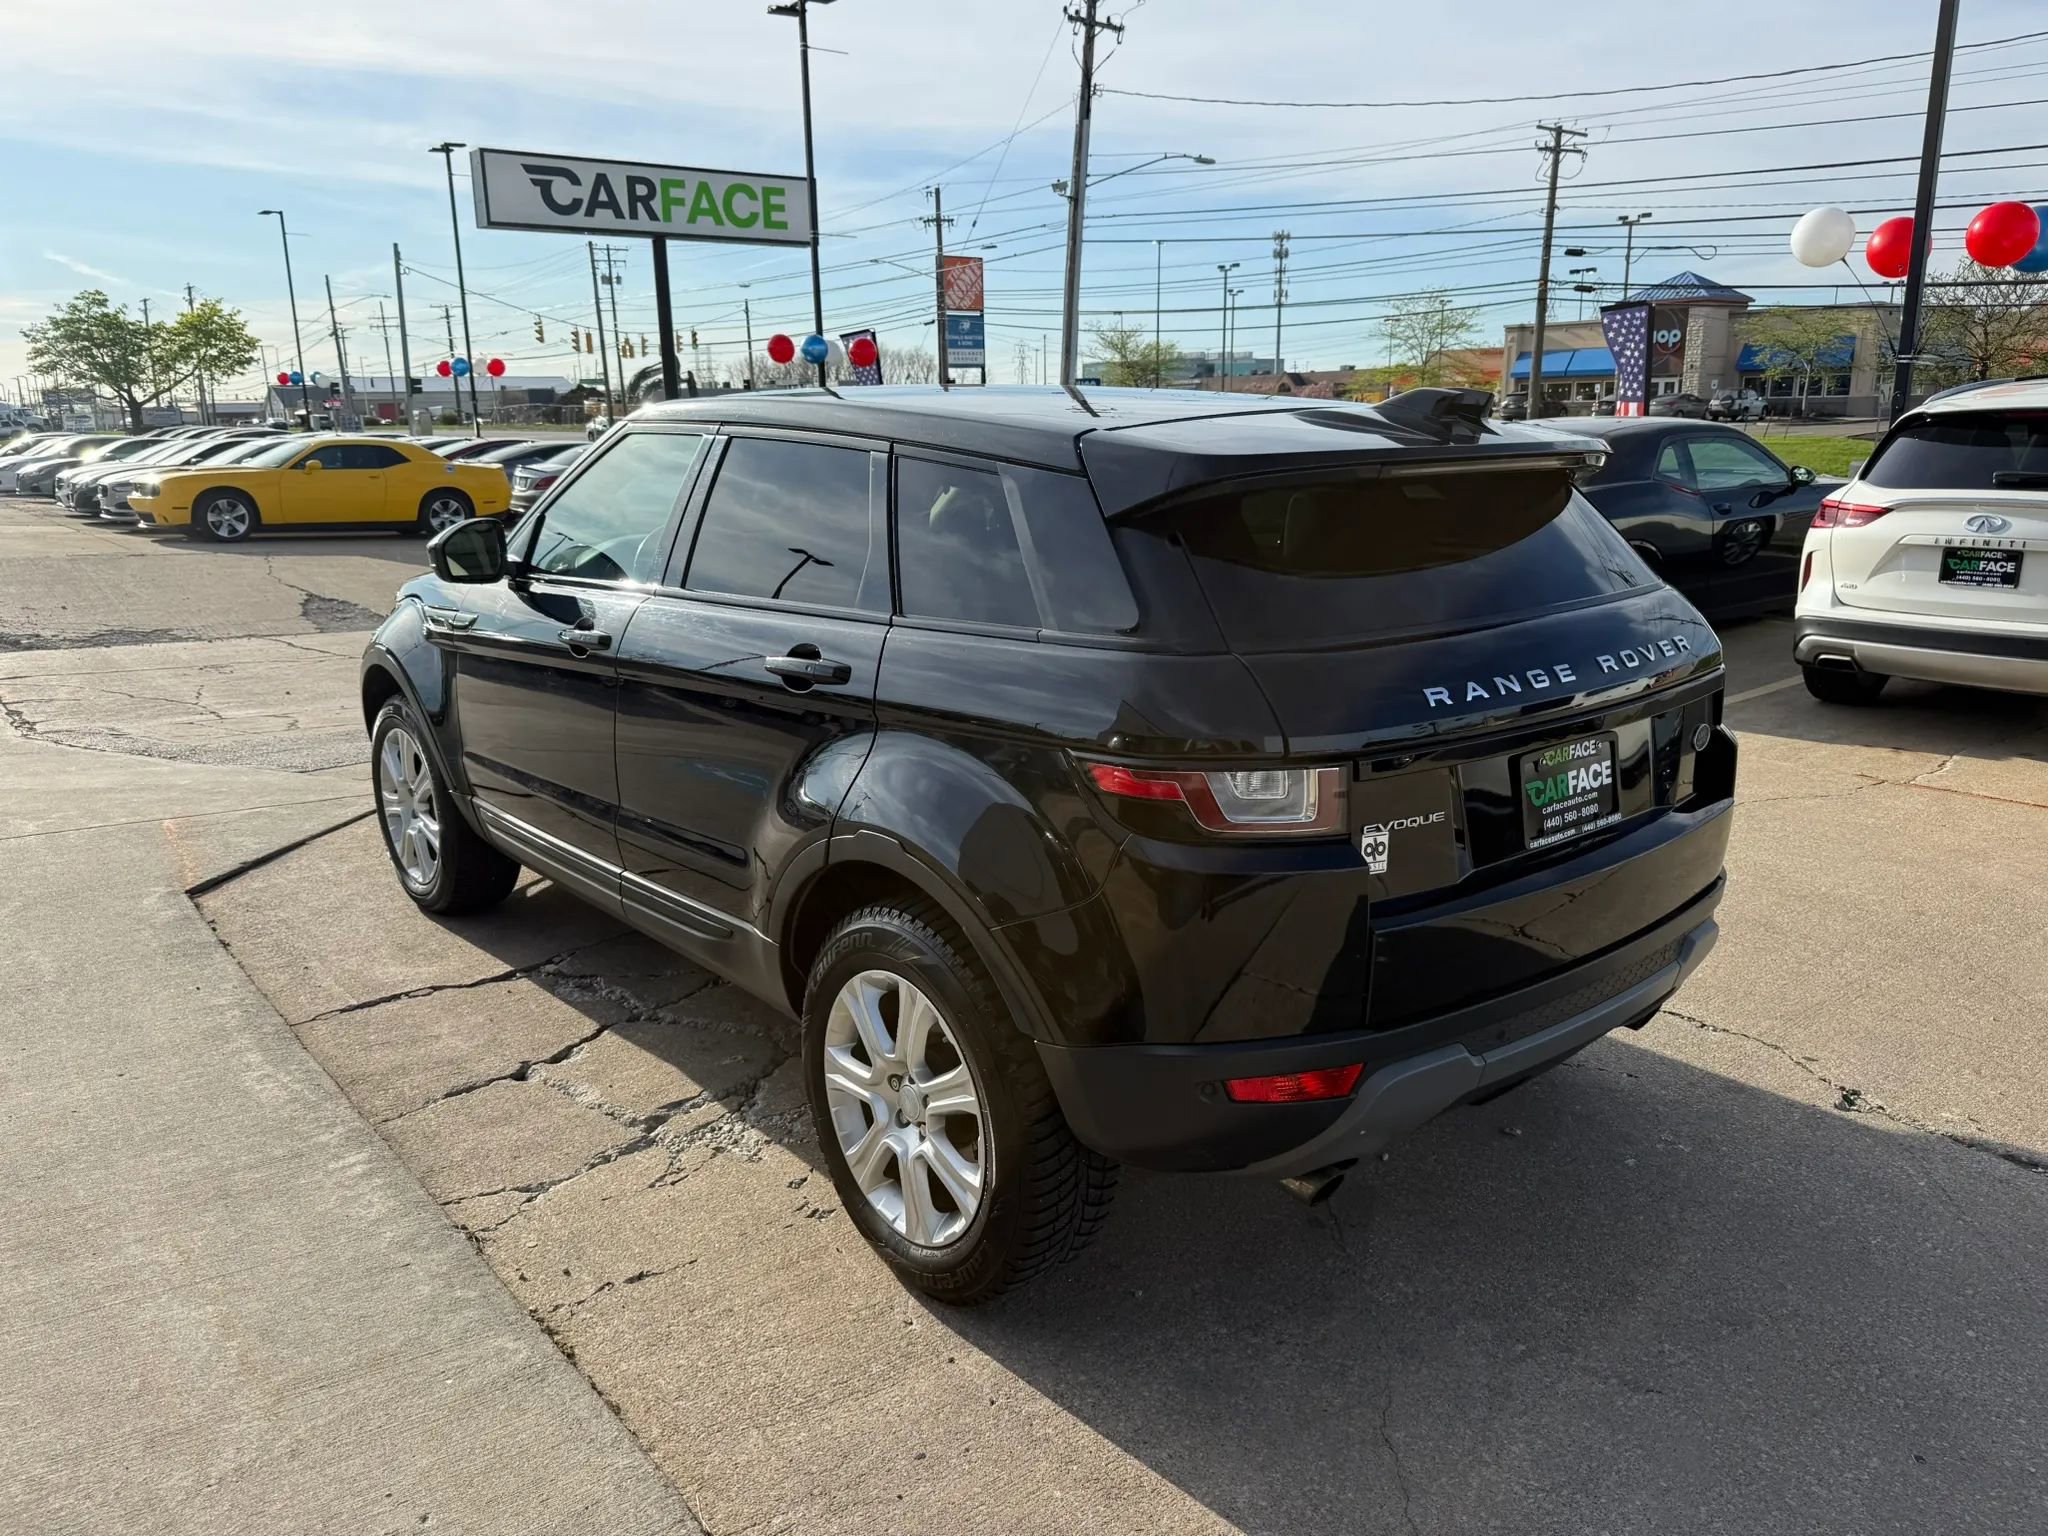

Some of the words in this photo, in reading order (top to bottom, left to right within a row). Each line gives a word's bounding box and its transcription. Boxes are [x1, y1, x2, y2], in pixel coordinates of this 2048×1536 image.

[520, 163, 789, 231] CARFACE
[1934, 538, 2026, 548] INFINITI
[1947, 559, 2015, 572] CARFACE
[1423, 663, 1577, 707] RANGE
[1595, 635, 1691, 674] ROVER
[1544, 739, 1596, 766] CARFACE
[1525, 760, 1612, 807] CARFACE
[1542, 791, 1598, 814] carfaceauto.com
[1363, 811, 1445, 834] EVOQUE
[1543, 815, 1563, 830] (440)
[1529, 828, 1576, 848] carfaceauto.com
